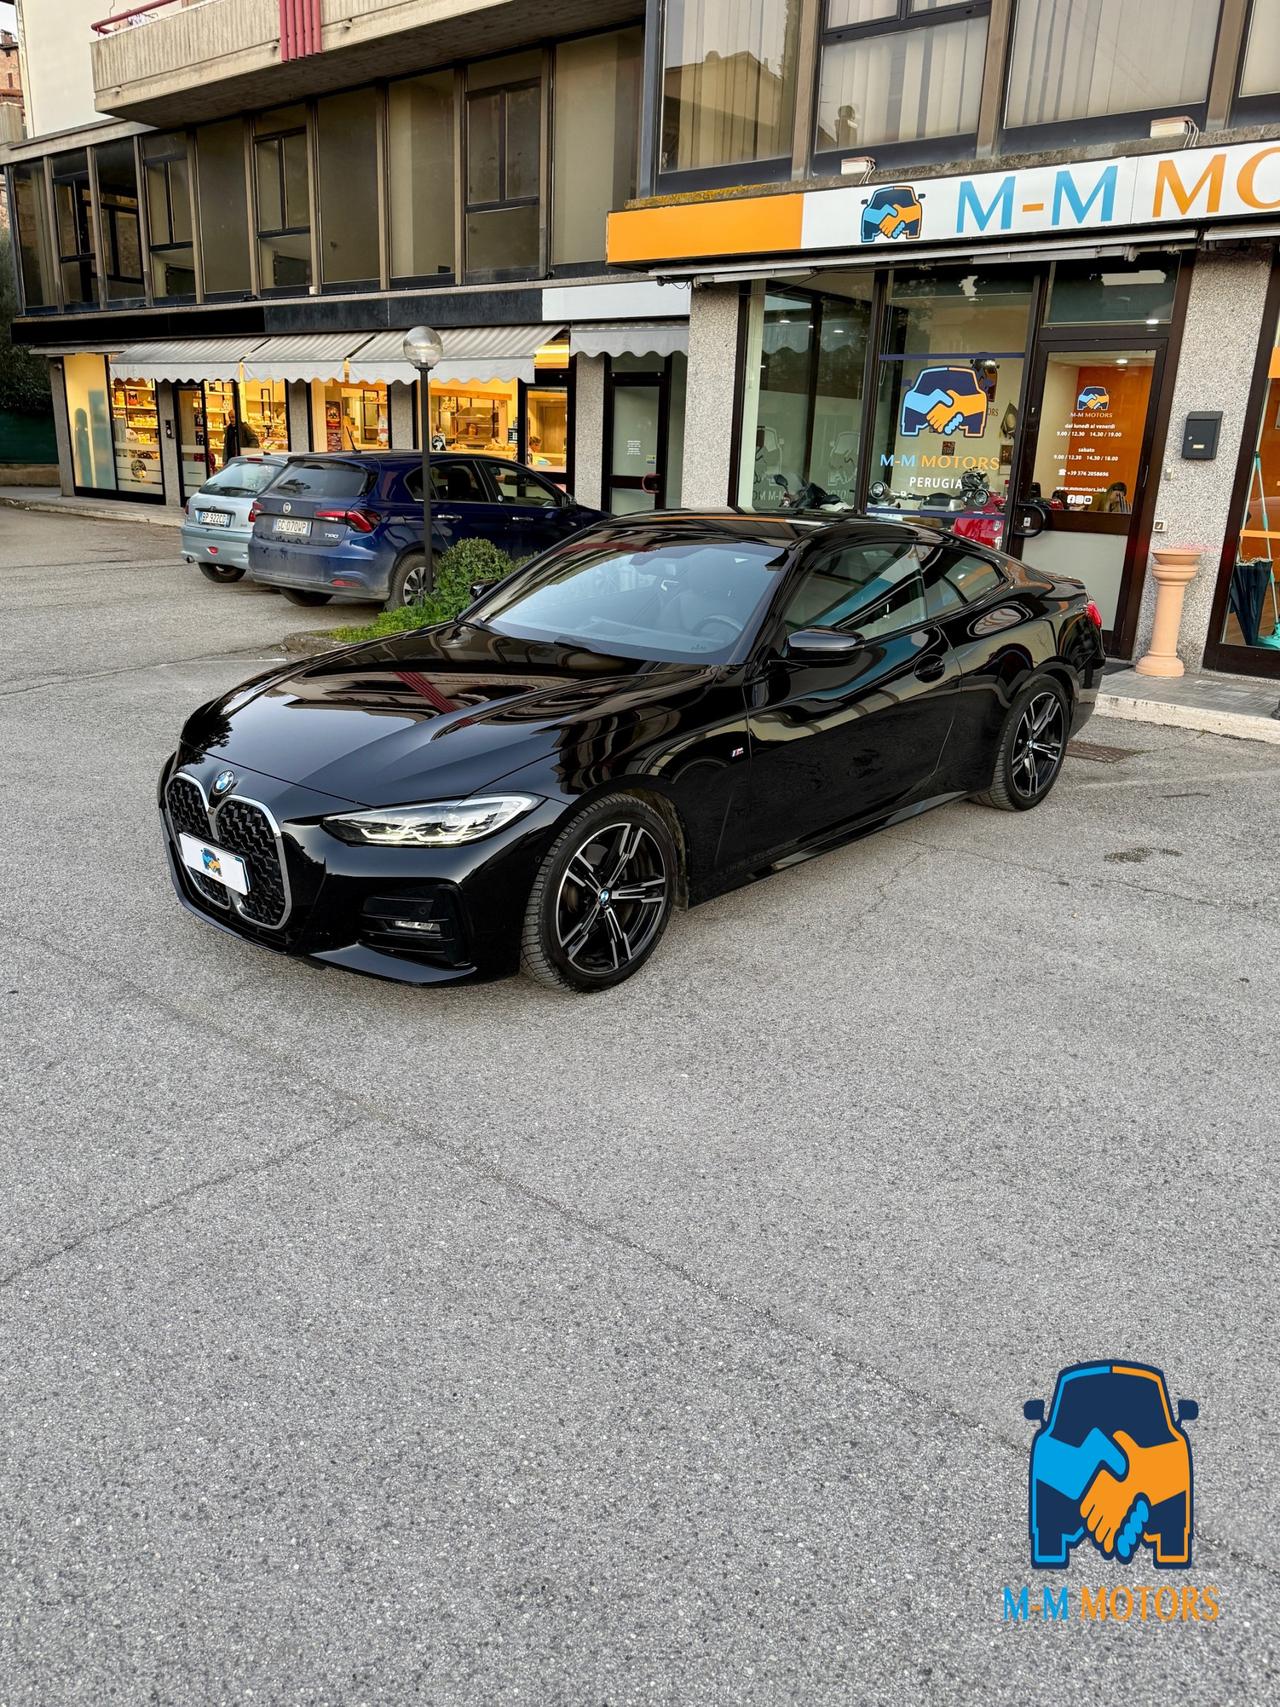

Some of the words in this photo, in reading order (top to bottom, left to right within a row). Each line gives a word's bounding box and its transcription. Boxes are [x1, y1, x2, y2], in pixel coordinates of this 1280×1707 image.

[956, 165, 1118, 233] M-M
[880, 454, 915, 467] M-M
[921, 455, 1000, 471] MOTORS
[909, 476, 963, 489] PERUGIA
